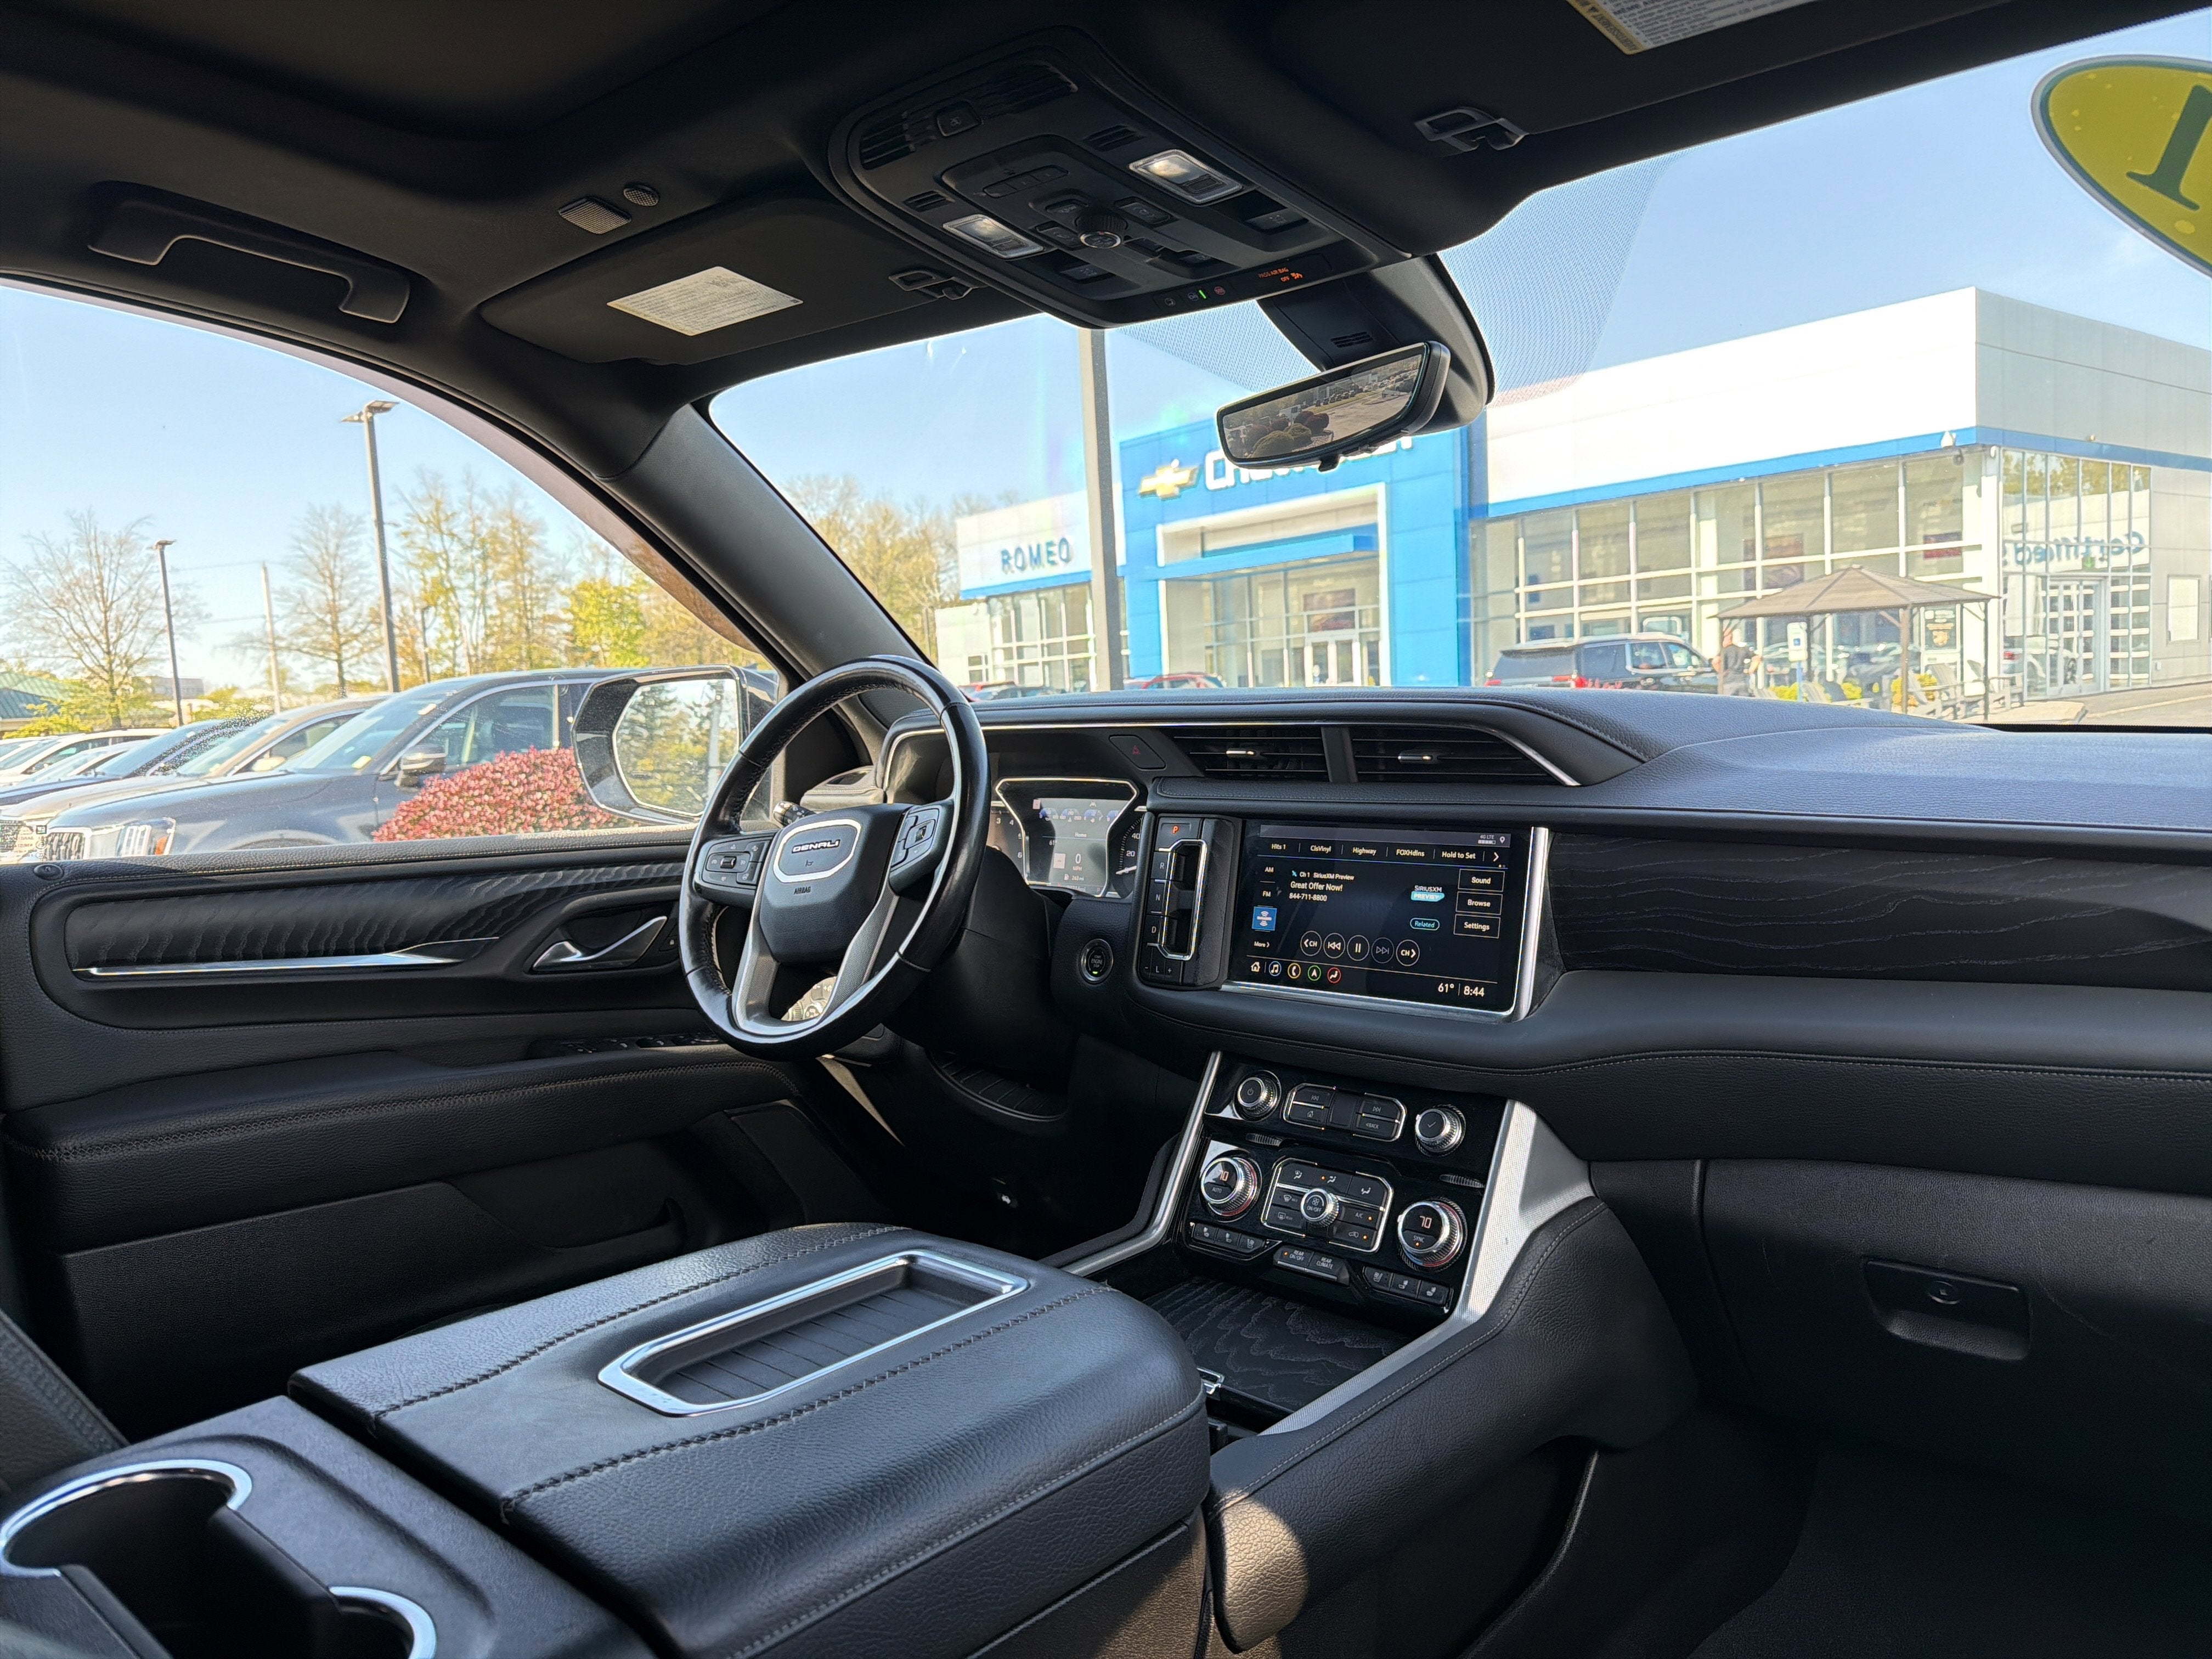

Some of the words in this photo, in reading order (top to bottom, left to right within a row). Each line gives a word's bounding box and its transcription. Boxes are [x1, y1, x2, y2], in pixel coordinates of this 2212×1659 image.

[1001, 537, 1071, 573] ROMEO
[1172, 825, 1179, 834] P
[792, 839, 840, 854] DENALI
[1310, 845, 1331, 854] ClsVinyl
[1352, 847, 1377, 856] Highway
[1396, 849, 1425, 857] FOXHdlns
[1075, 853, 1081, 865] 0
[1471, 876, 1491, 884] Sound
[794, 886, 811, 895] AIRBAG
[1290, 881, 1307, 889] Great
[1308, 882, 1324, 890] Offer
[1325, 883, 1343, 891] Now!
[1289, 892, 1328, 902] 844-711-8800
[1467, 899, 1491, 907] Browse
[1414, 920, 1435, 928] Related
[1464, 921, 1490, 932] Settings
[1437, 983, 1454, 993] 61°
[1463, 985, 1485, 997] 8:44
[1419, 1215, 1432, 1229] 70
[1413, 1235, 1425, 1243] SYNC
[1316, 1261, 1334, 1269] CLIMATE
